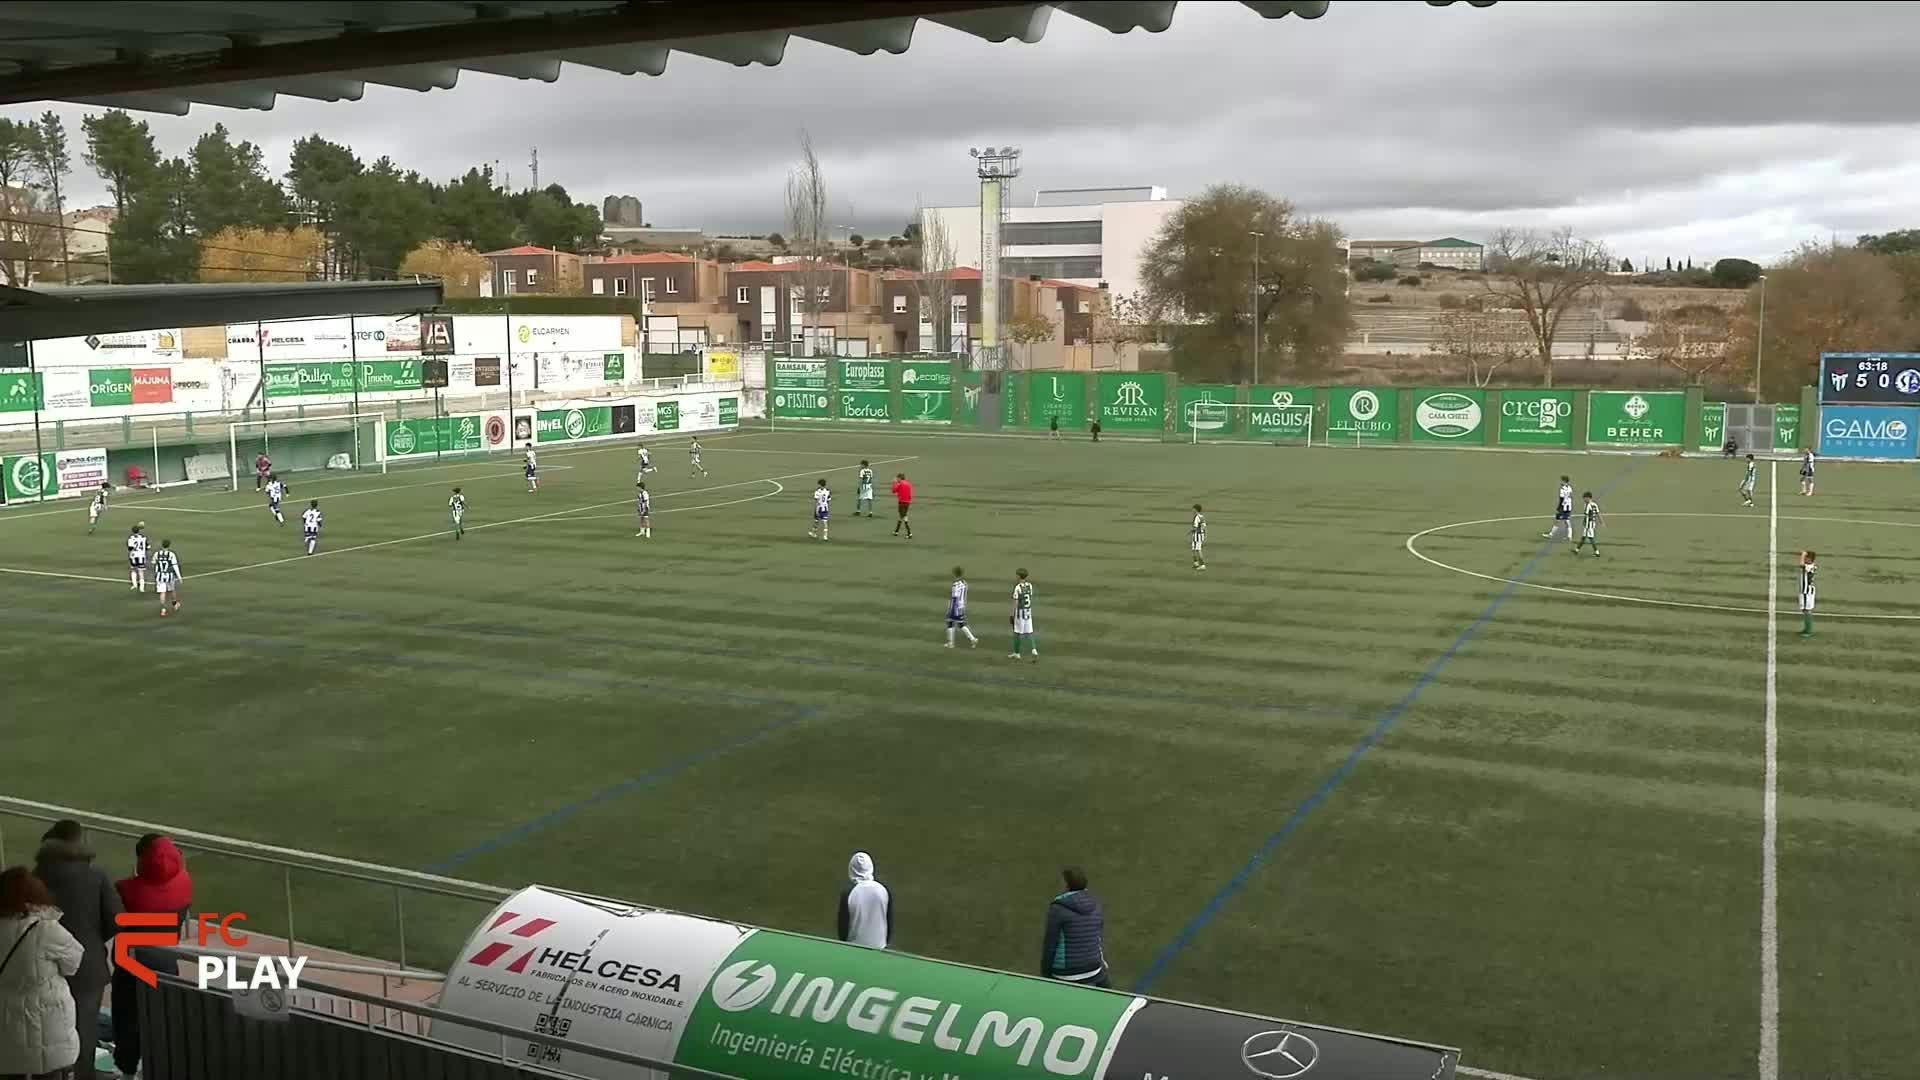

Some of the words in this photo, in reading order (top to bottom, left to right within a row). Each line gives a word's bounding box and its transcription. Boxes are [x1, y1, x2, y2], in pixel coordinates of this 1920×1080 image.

[532, 327, 570, 336] ELCARMEN
[1858, 362, 1888, 371] 63:18
[363, 364, 393, 388] Pinucho
[1856, 373, 1868, 387] 5
[1878, 373, 1890, 388] 0
[787, 393, 817, 409] FISAN
[1103, 406, 1158, 417] REVISAN
[1502, 400, 1572, 424] crego
[1251, 412, 1312, 427] MAGUISA
[1336, 421, 1348, 429] EL
[1354, 421, 1392, 431] RUBIO
[1606, 427, 1664, 438] BEHER
[1826, 418, 1907, 440] GAMO
[133, 541, 144, 552] 24
[159, 560, 169, 572] 17
[1023, 593, 1032, 608] 3
[537, 946, 683, 993] HELCESA
[529, 969, 584, 988] FABRICAOS
[584, 980, 599, 990] EN
[598, 983, 631, 998] ACERO
[630, 992, 685, 1009] INOXIDABLE
[458, 975, 473, 988] AL
[474, 978, 527, 1000] SERVICIO
[527, 989, 544, 1004] DE
[560, 997, 624, 1022] INDUSTRIA
[770, 971, 1100, 1077] INGELMO
[709, 1022, 814, 1066] Ingeniería
[819, 1046, 912, 1080] Eléctrica
